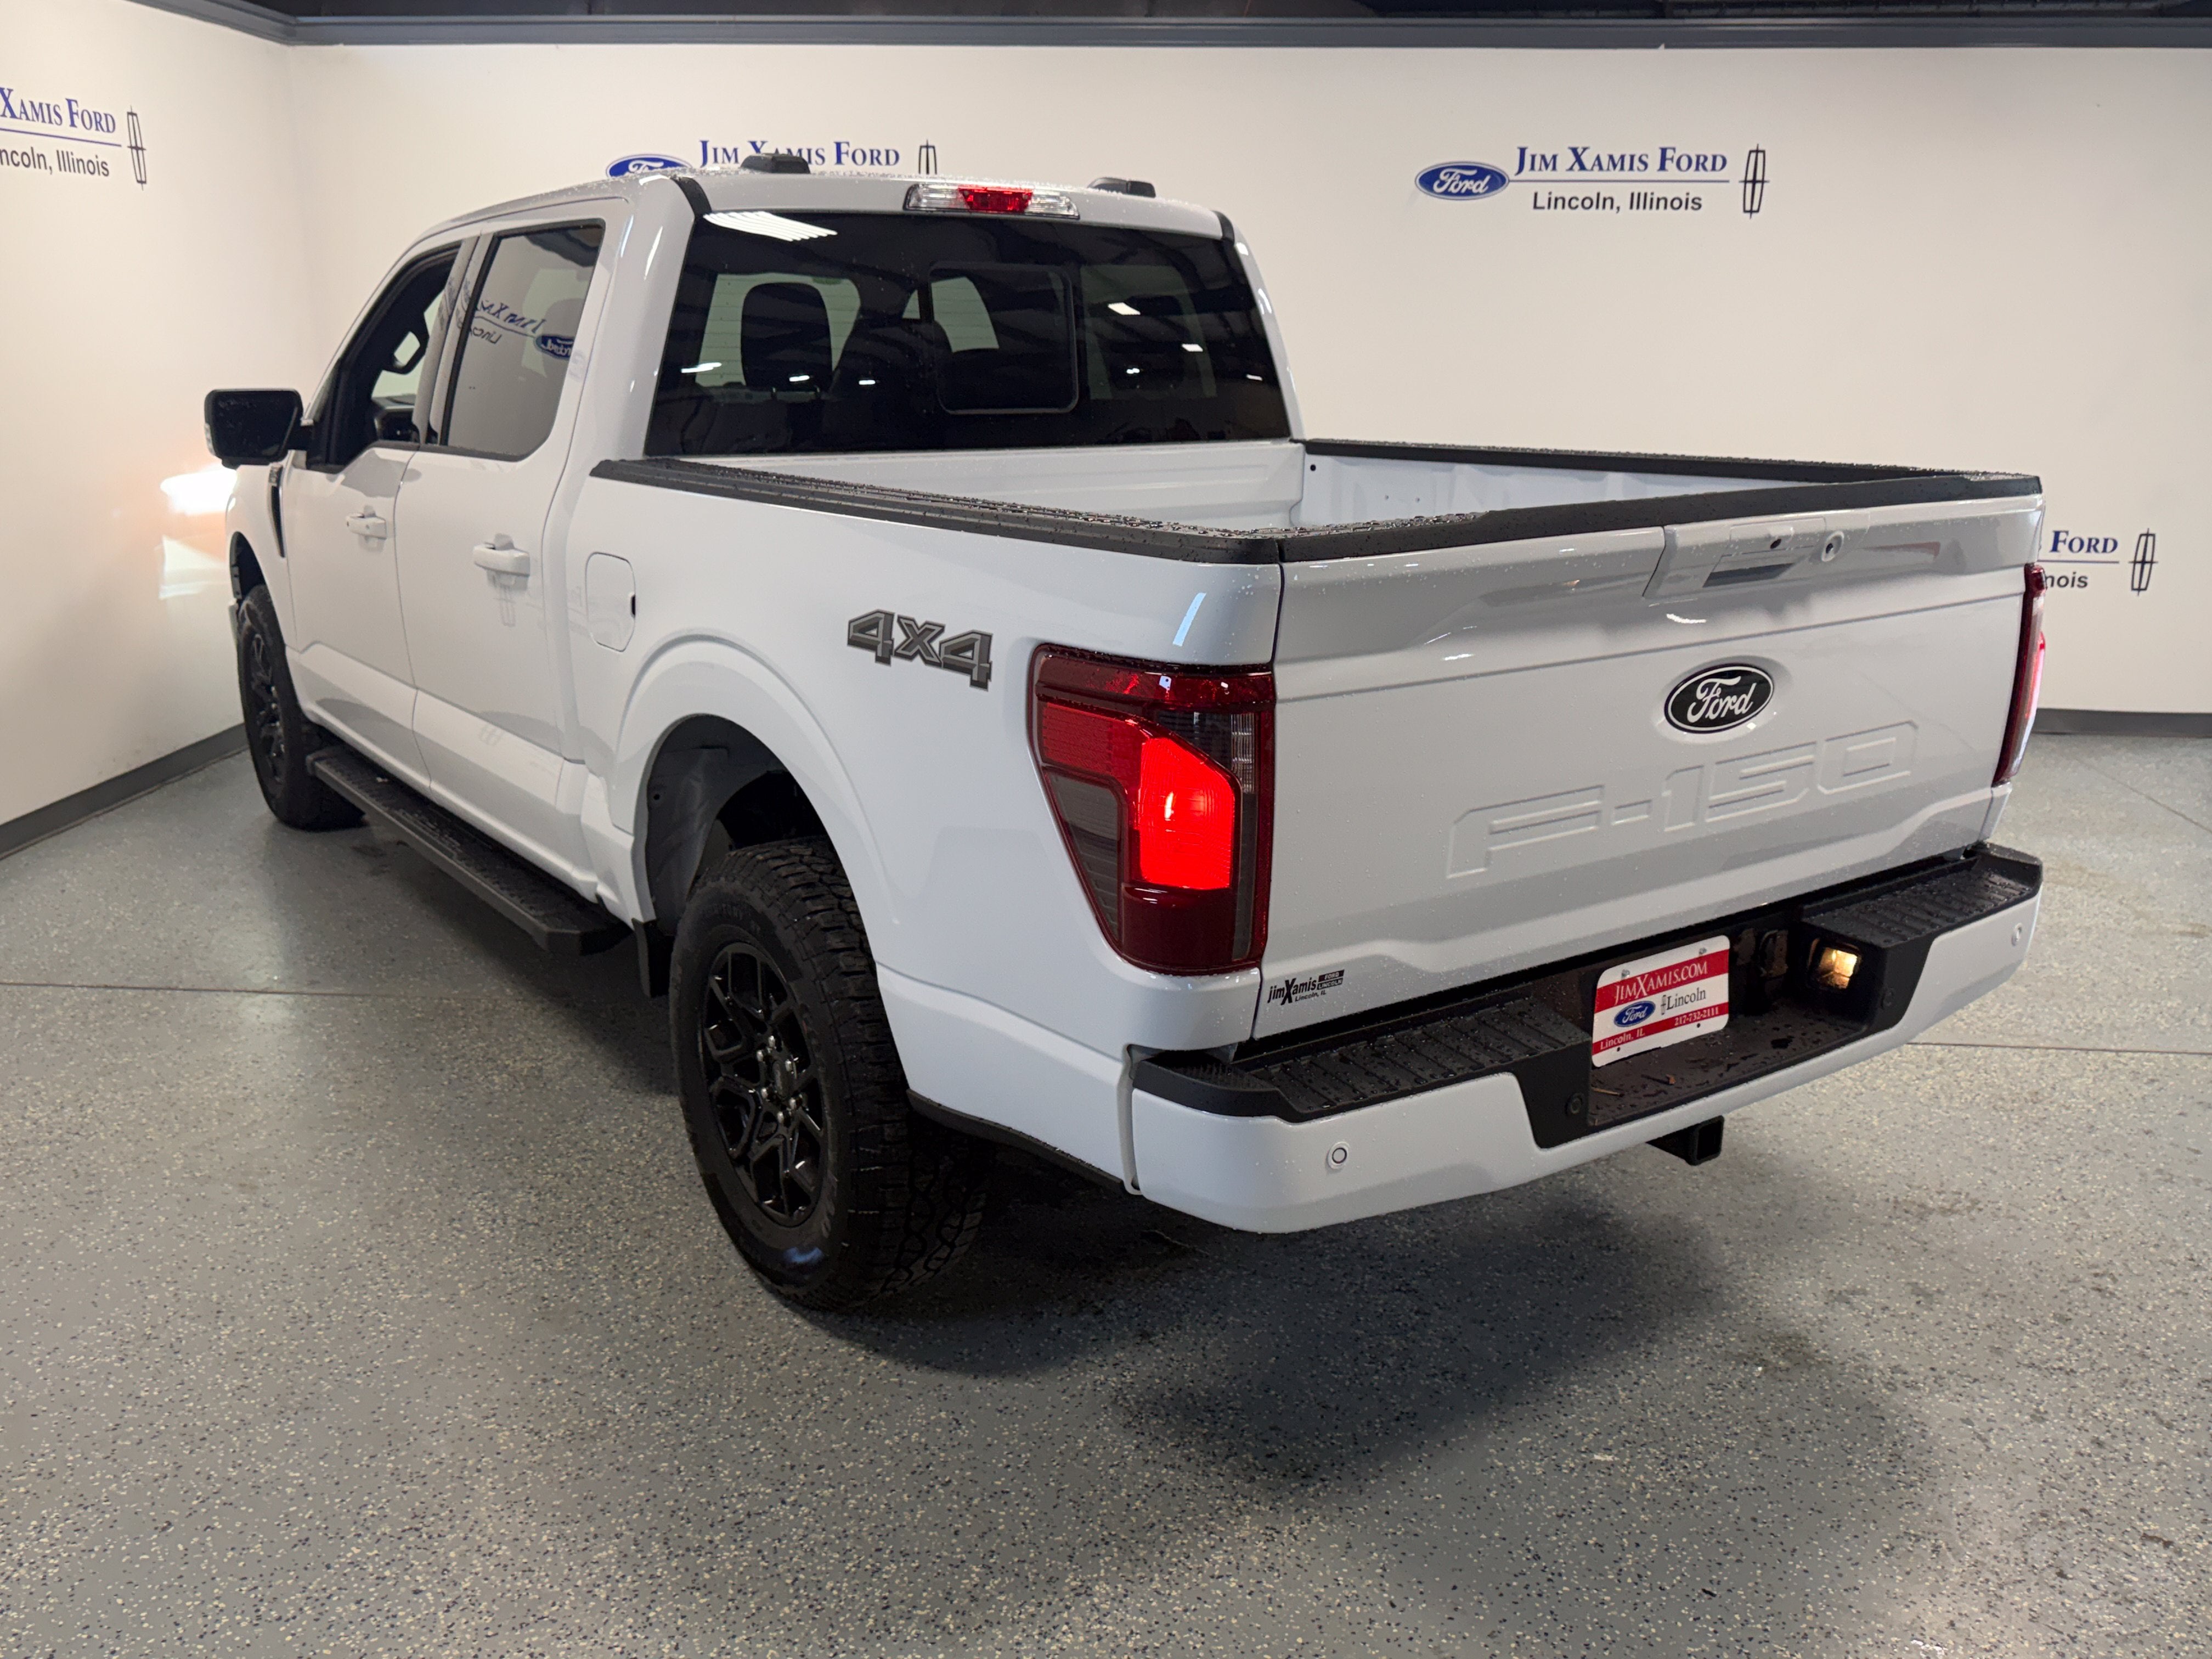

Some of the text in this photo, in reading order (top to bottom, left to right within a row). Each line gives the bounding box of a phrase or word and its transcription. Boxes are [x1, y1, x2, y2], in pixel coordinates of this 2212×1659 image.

[0, 87, 116, 133] XAMIS FORD
[0, 146, 110, 177] ncoln, Illinois
[699, 139, 739, 168] JIM
[834, 141, 900, 166] FORD
[1514, 146, 1728, 176] JIM XAMIS FORD
[1433, 168, 1489, 195] Ford
[1532, 191, 1703, 213] Lincoln, Illinois
[2049, 530, 2118, 554] FORD
[2044, 571, 2089, 589] nois
[1686, 675, 1757, 723] Ford
[1446, 720, 1919, 879] F-150
[1614, 961, 1708, 1006] JIMXAMIS.COM
[1666, 987, 1707, 1010] Lincoln
[1622, 1005, 1649, 1024] Ford
[1674, 1007, 1719, 1026] 217-732-2111
[1636, 1028, 1645, 1037] IL
